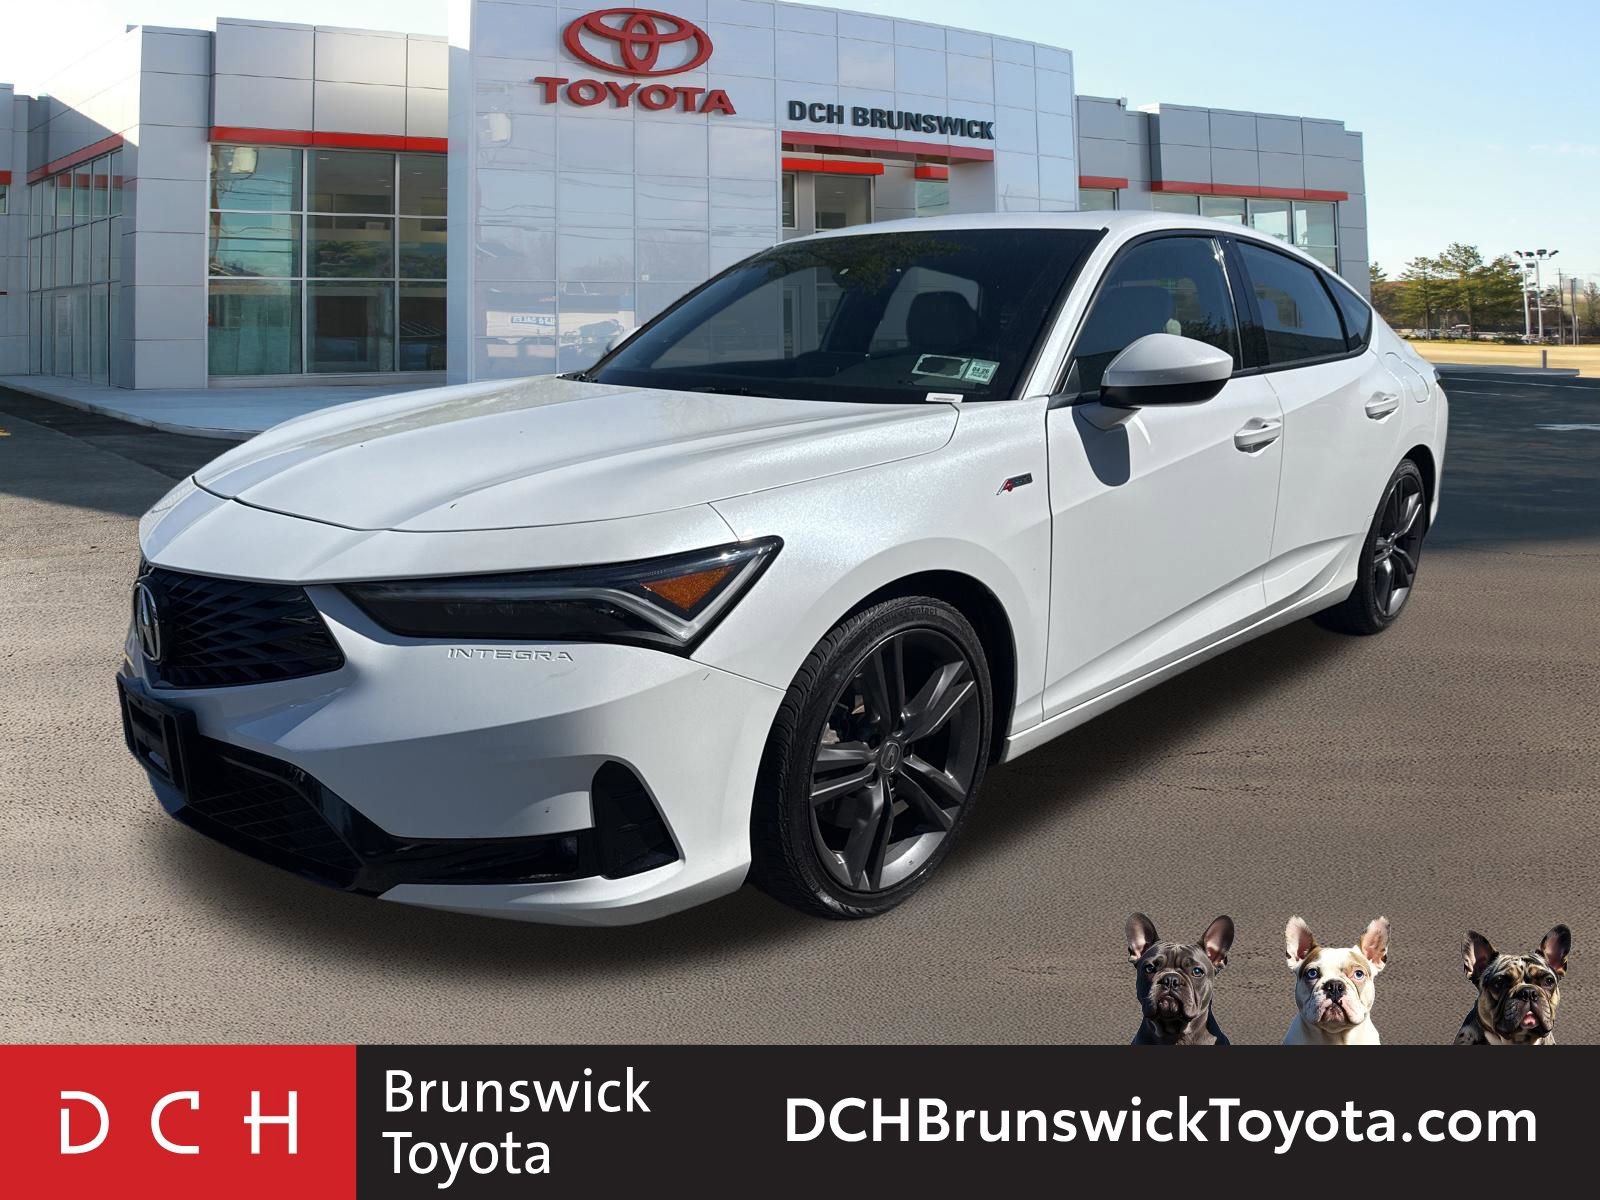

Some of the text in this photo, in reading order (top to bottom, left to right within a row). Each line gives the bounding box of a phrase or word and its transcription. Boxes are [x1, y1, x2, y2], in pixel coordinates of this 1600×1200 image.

[535, 76, 736, 115] TOYOTA
[788, 100, 995, 140] DCH BRUNSWICK
[447, 648, 575, 662] INTEGRA
